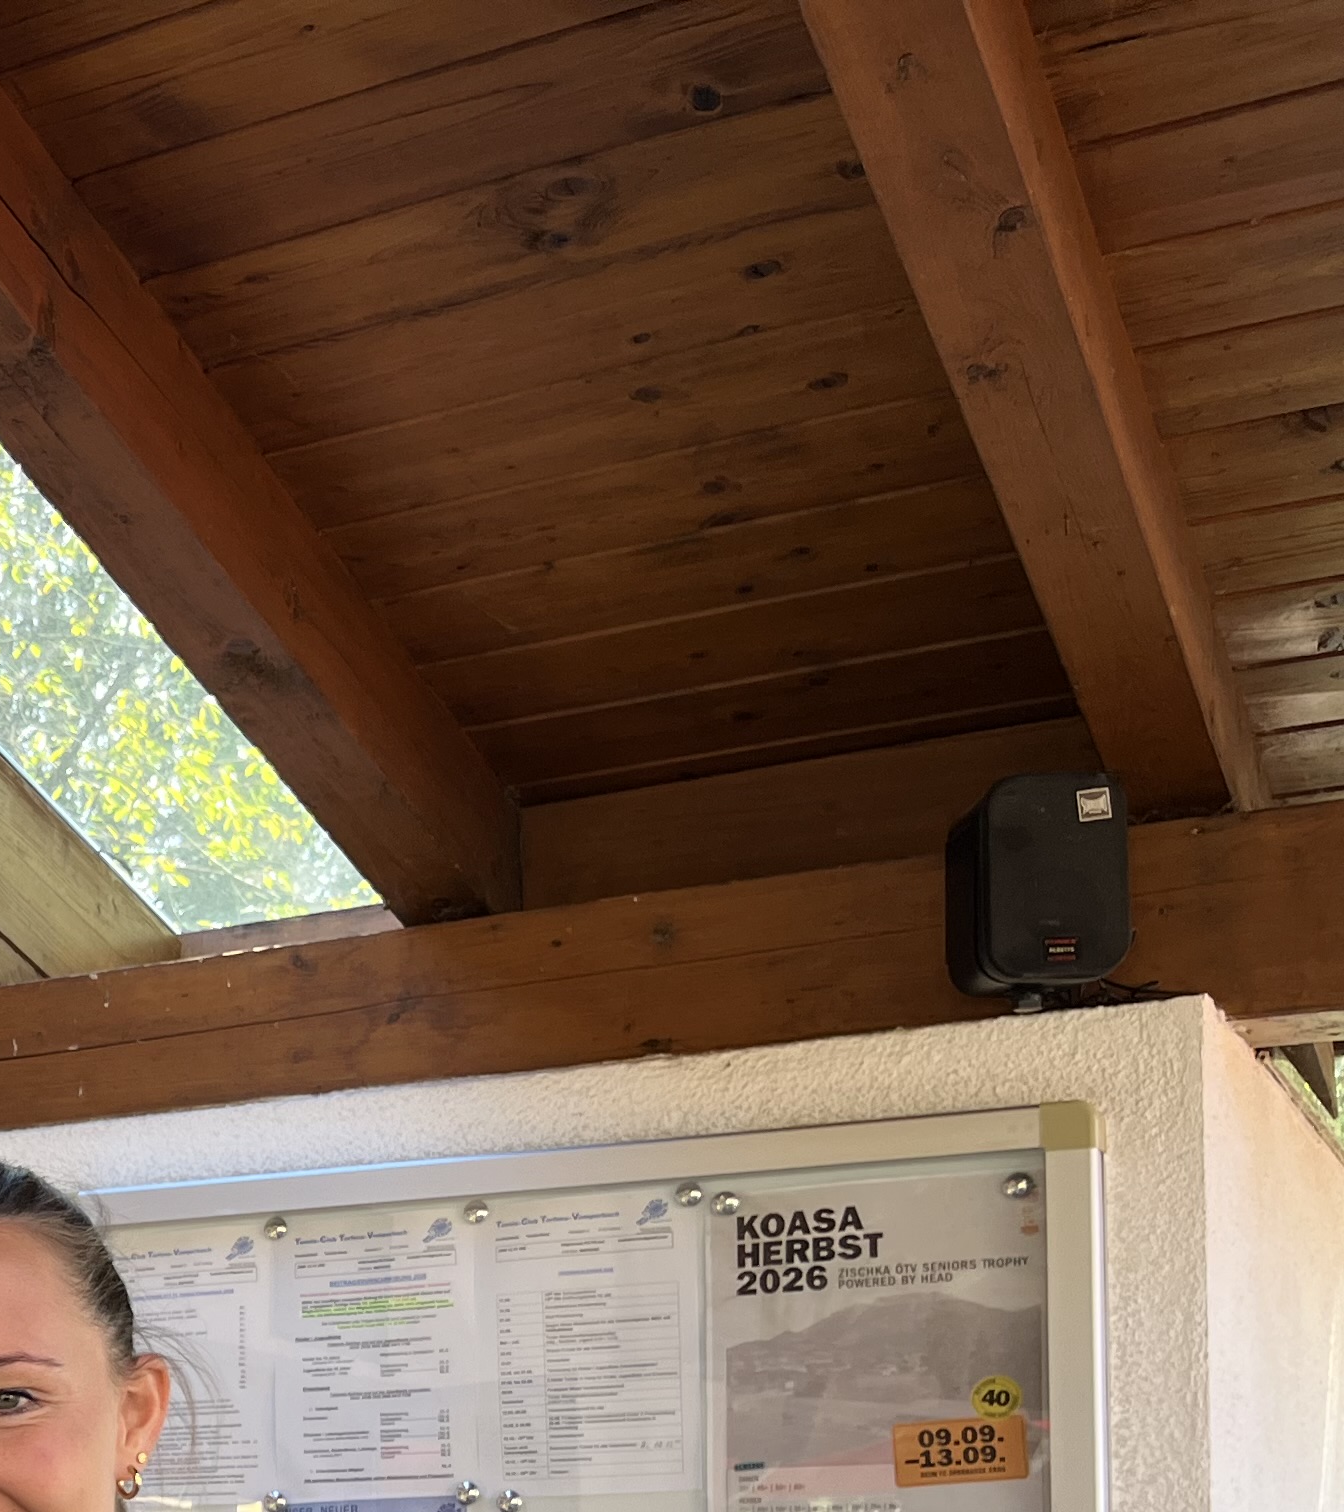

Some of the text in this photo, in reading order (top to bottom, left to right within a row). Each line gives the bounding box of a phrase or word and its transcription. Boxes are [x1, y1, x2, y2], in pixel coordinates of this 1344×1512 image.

[736, 1206, 864, 1240] KOASA
[737, 1232, 883, 1268] HERBST
[838, 1265, 890, 1279] ZISCHKA
[922, 1259, 977, 1273] SENIORS
[982, 1256, 1029, 1269] TROPHY
[736, 1266, 828, 1296] 2026
[838, 1272, 953, 1290] POWERED BY HEAD
[981, 1389, 1010, 1406] 40
[918, 1425, 1004, 1448] 09.09.
